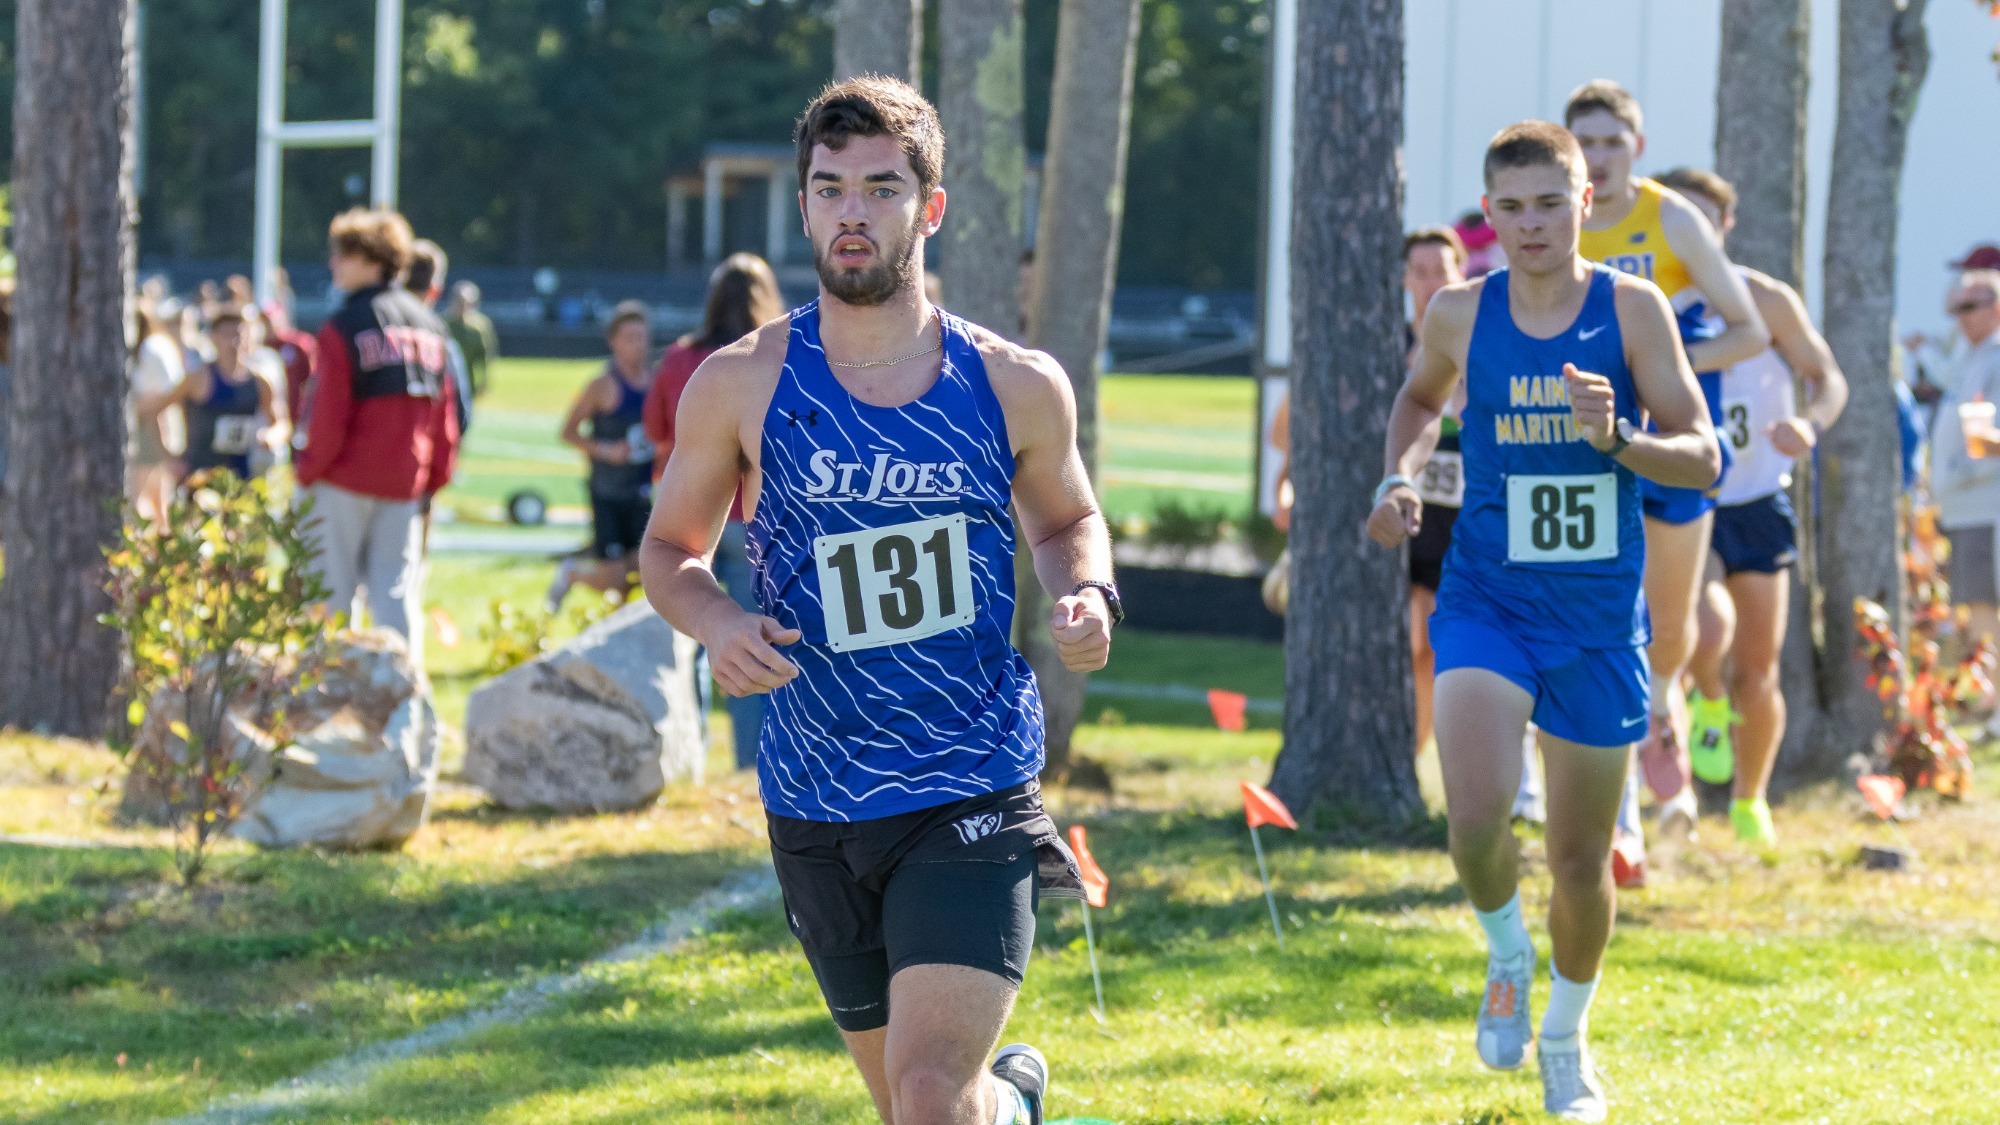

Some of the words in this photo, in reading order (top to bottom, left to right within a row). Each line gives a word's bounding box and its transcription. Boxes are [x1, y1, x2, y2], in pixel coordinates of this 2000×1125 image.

[1510, 374, 1571, 407] MAIN
[1726, 404, 1749, 449] 3
[1531, 484, 1595, 551] 85
[827, 527, 956, 636] 131
